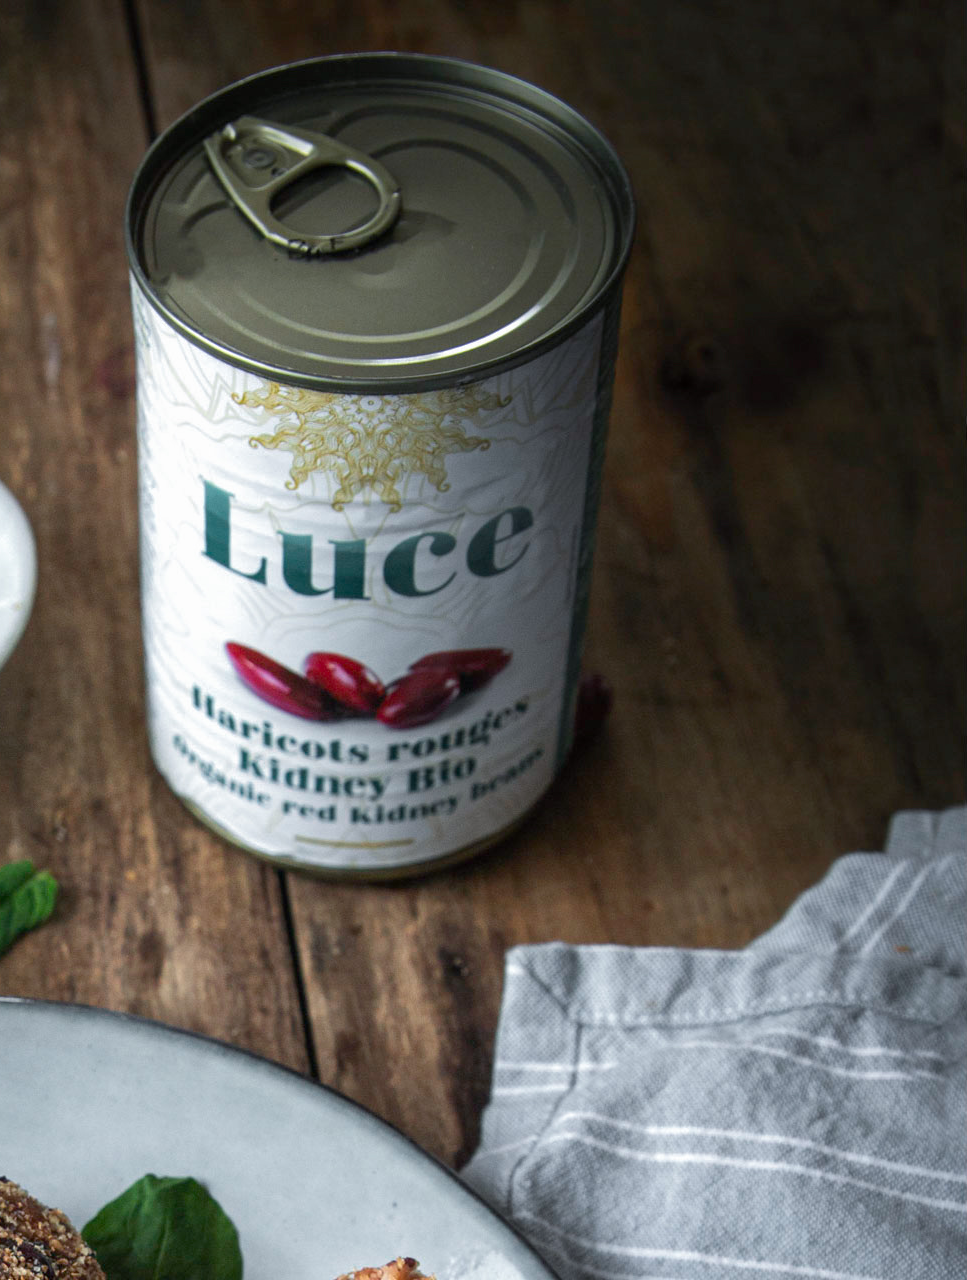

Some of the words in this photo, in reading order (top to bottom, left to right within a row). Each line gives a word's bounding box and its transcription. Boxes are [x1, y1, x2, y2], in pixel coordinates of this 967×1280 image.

[199, 474, 534, 600] Luce
[191, 684, 369, 764] Haricots
[386, 696, 530, 762] rouges
[173, 733, 271, 804] Organic
[282, 800, 337, 823] red
[239, 746, 390, 801] Kidney
[407, 757, 476, 794] Bio
